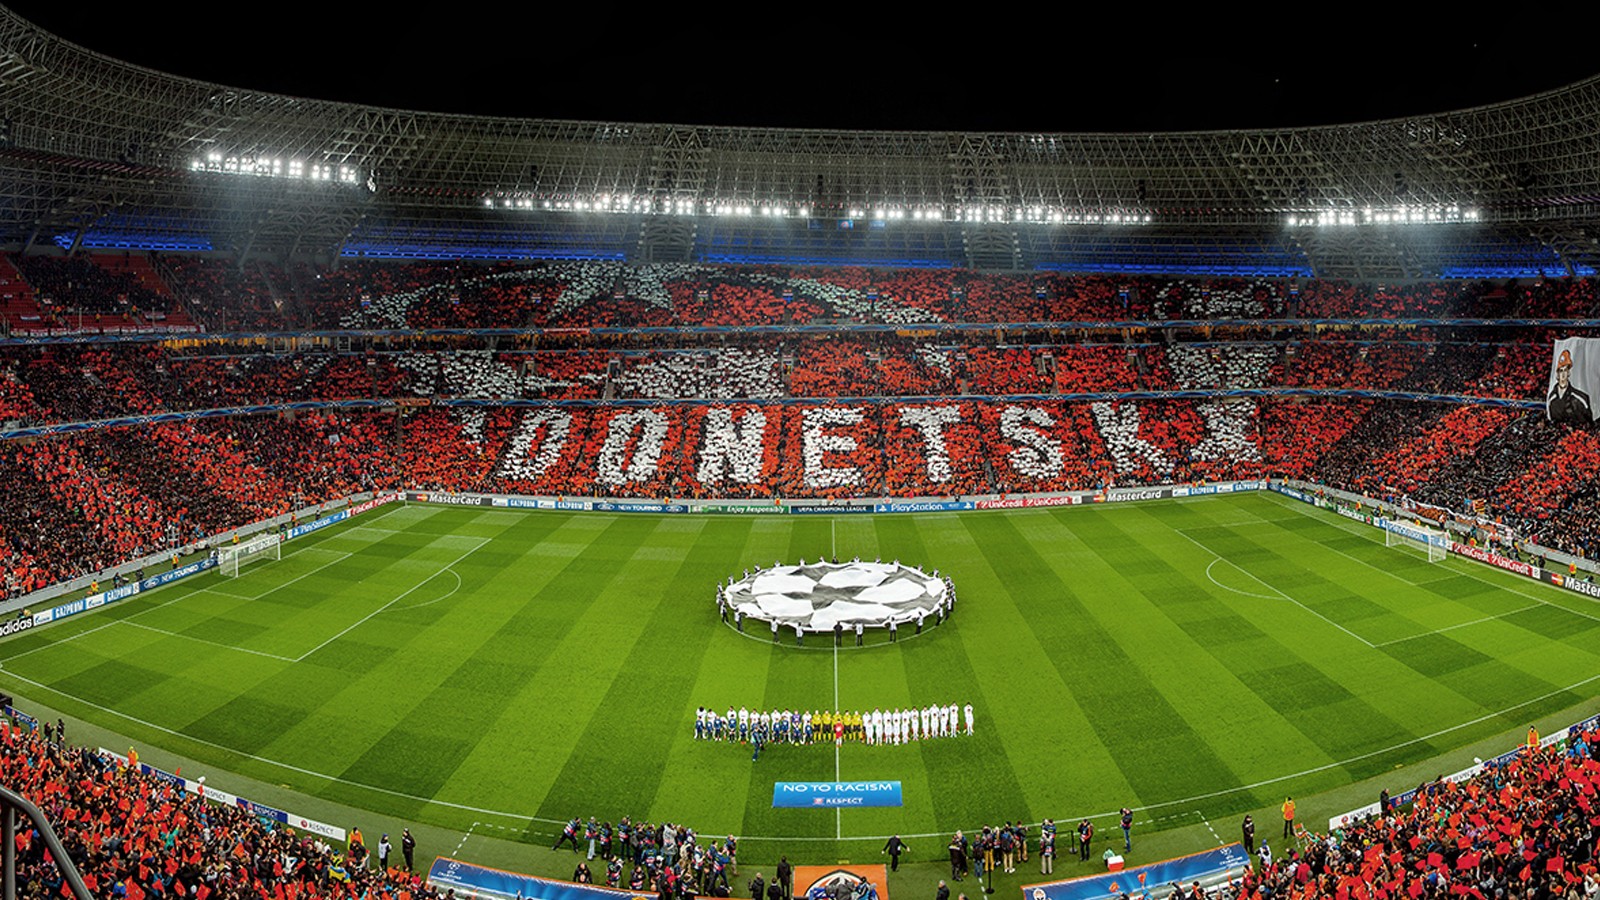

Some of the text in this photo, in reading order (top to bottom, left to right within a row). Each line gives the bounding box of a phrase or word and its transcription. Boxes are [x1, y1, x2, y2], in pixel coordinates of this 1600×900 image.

[428, 493, 481, 506] MasterCard
[1107, 490, 1162, 502] MasterCard
[988, 499, 1024, 509] UniCredit
[1034, 497, 1069, 506] UniCredit
[727, 504, 745, 514] Enjoy
[1498, 555, 1530, 575] UniCredit
[783, 783, 893, 793] NO TO RACISM
[826, 797, 863, 805] RESPECT
[309, 822, 334, 836] RESPECT
